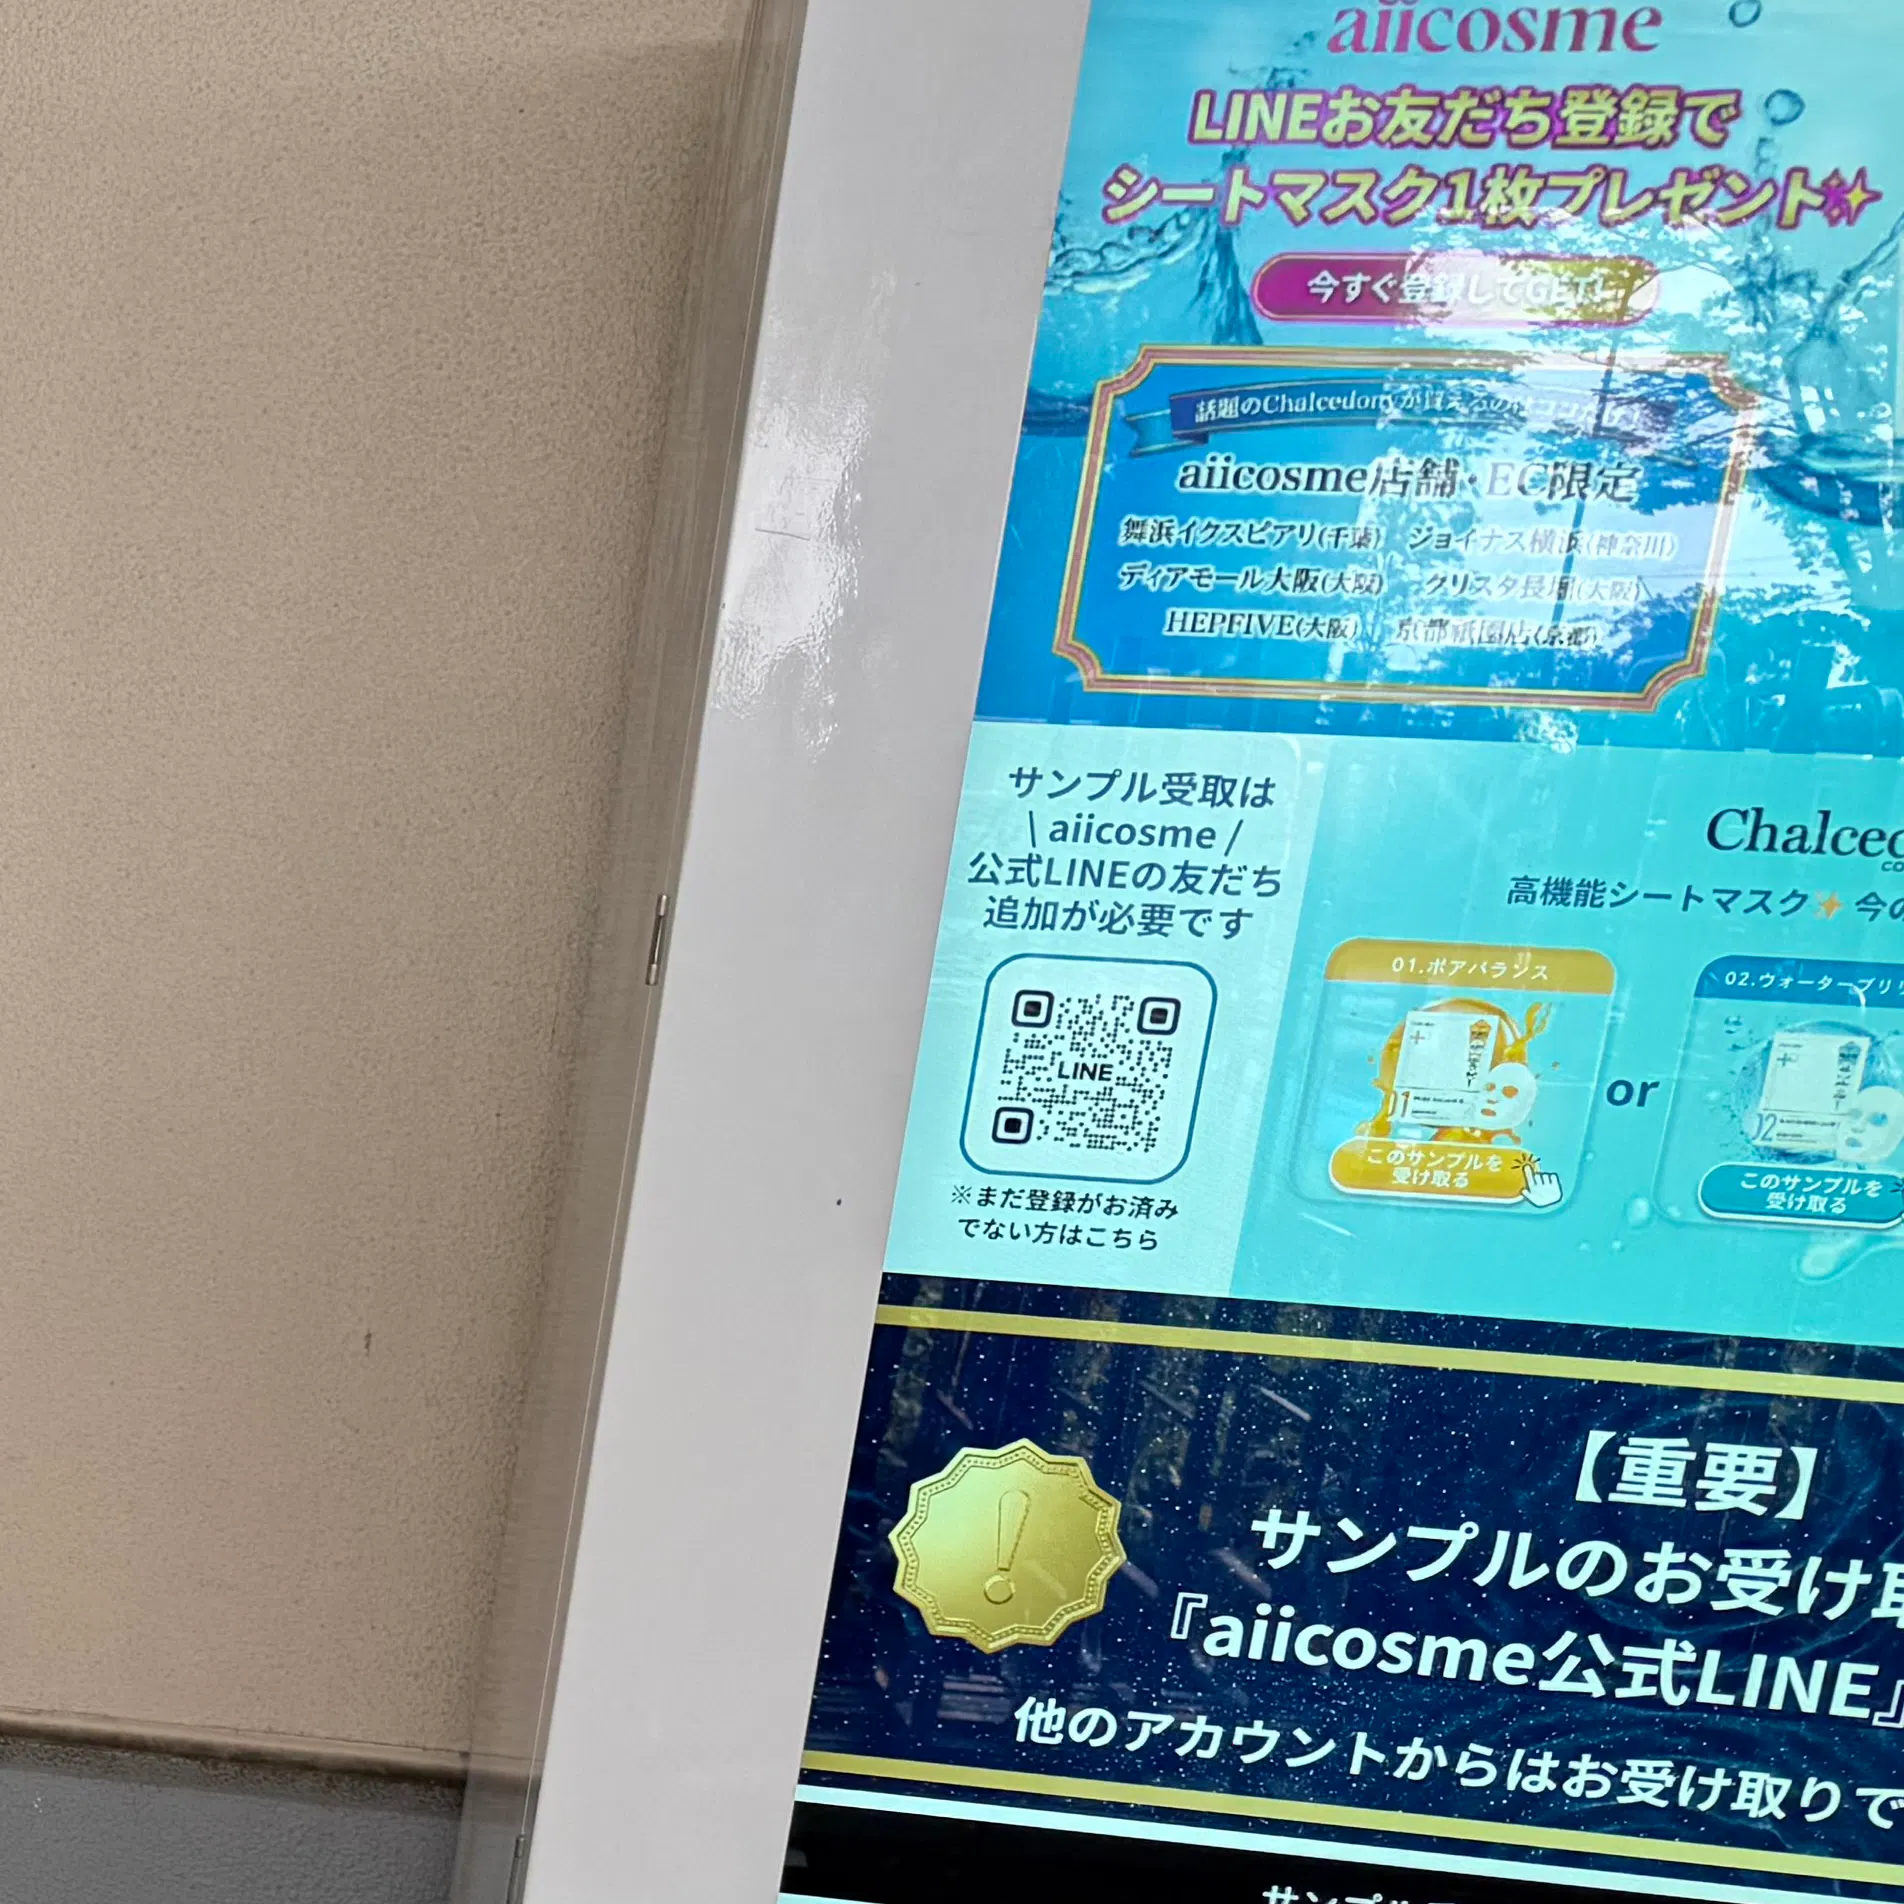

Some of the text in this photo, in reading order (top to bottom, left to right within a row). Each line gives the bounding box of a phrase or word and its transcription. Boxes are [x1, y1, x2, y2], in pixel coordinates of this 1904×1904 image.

[1327, 0, 1664, 54] aiicosme
[1189, 80, 1743, 151] LINEお友だち登録で
[1101, 161, 1834, 230] シートマスク1枚プレゼント
[1118, 562, 1385, 596] ディアモール大阪(大阪)
[1164, 608, 1361, 640] HEPFIVE(大阪)
[1008, 766, 1277, 809] サンプル受取は
[1048, 812, 1218, 850] aiicosme
[966, 850, 1283, 899] 公式LINEの友だち
[1505, 874, 1809, 919] 高機能シートマスク
[982, 895, 1255, 941] 追加が必要です
[1056, 1059, 1114, 1082] LINE
[1605, 1075, 1661, 1109] or
[1366, 1146, 1504, 1173] このサンプルを
[1391, 1168, 1470, 1190] 受け取る
[1740, 1171, 1884, 1198] このサンプルを
[951, 1184, 1179, 1221] ※まだ登録がお済み
[1765, 1191, 1847, 1214] 受け取る
[958, 1216, 1159, 1251] でない方はこちら
[1574, 1429, 1819, 1521] 【重要】
[1169, 1590, 1904, 1729] 『aiicosme公式LINE』
[1013, 1696, 1904, 1831] 他のアカウントからはお受け取りで
